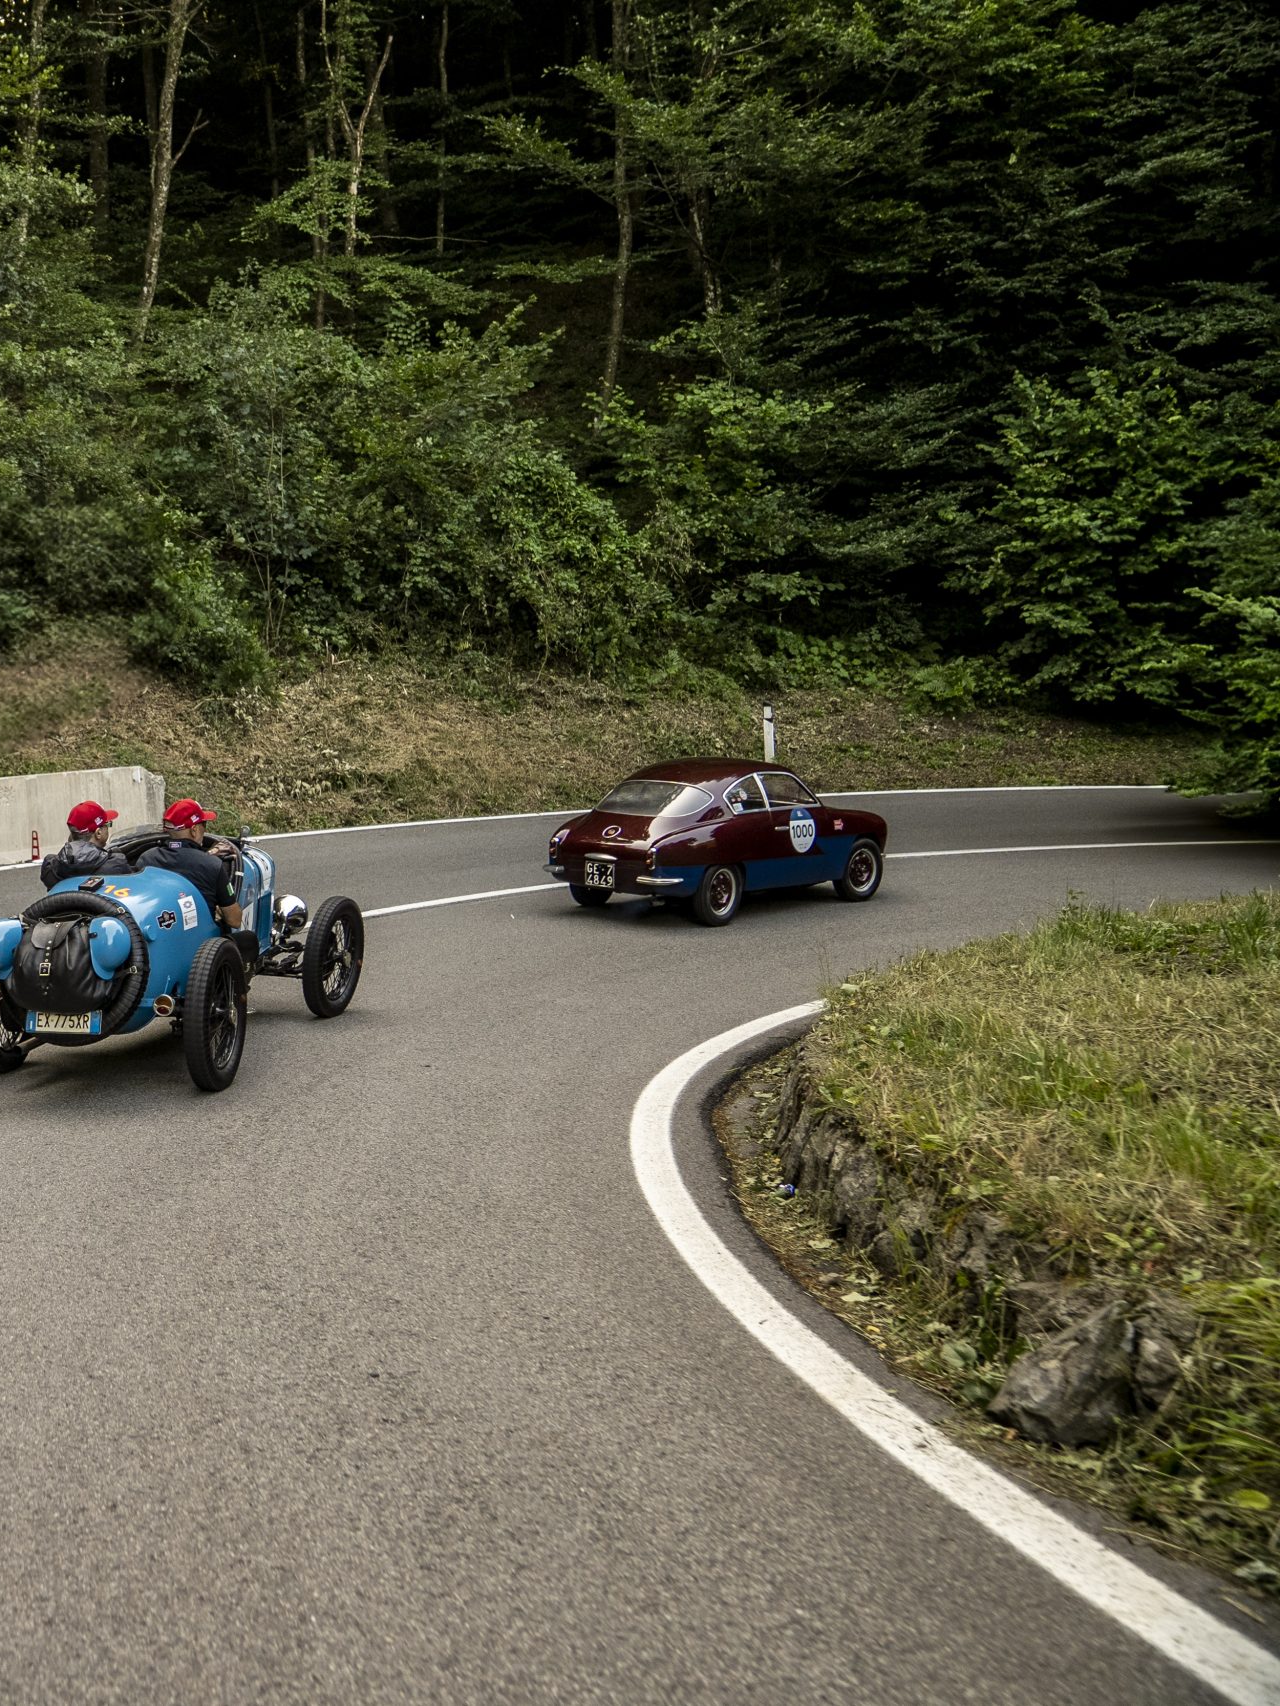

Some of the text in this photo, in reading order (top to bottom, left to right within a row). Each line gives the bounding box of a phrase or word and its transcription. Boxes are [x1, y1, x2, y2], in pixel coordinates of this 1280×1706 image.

[791, 823, 814, 839] 1000
[586, 873, 613, 886] 4849
[103, 885, 131, 897] 16
